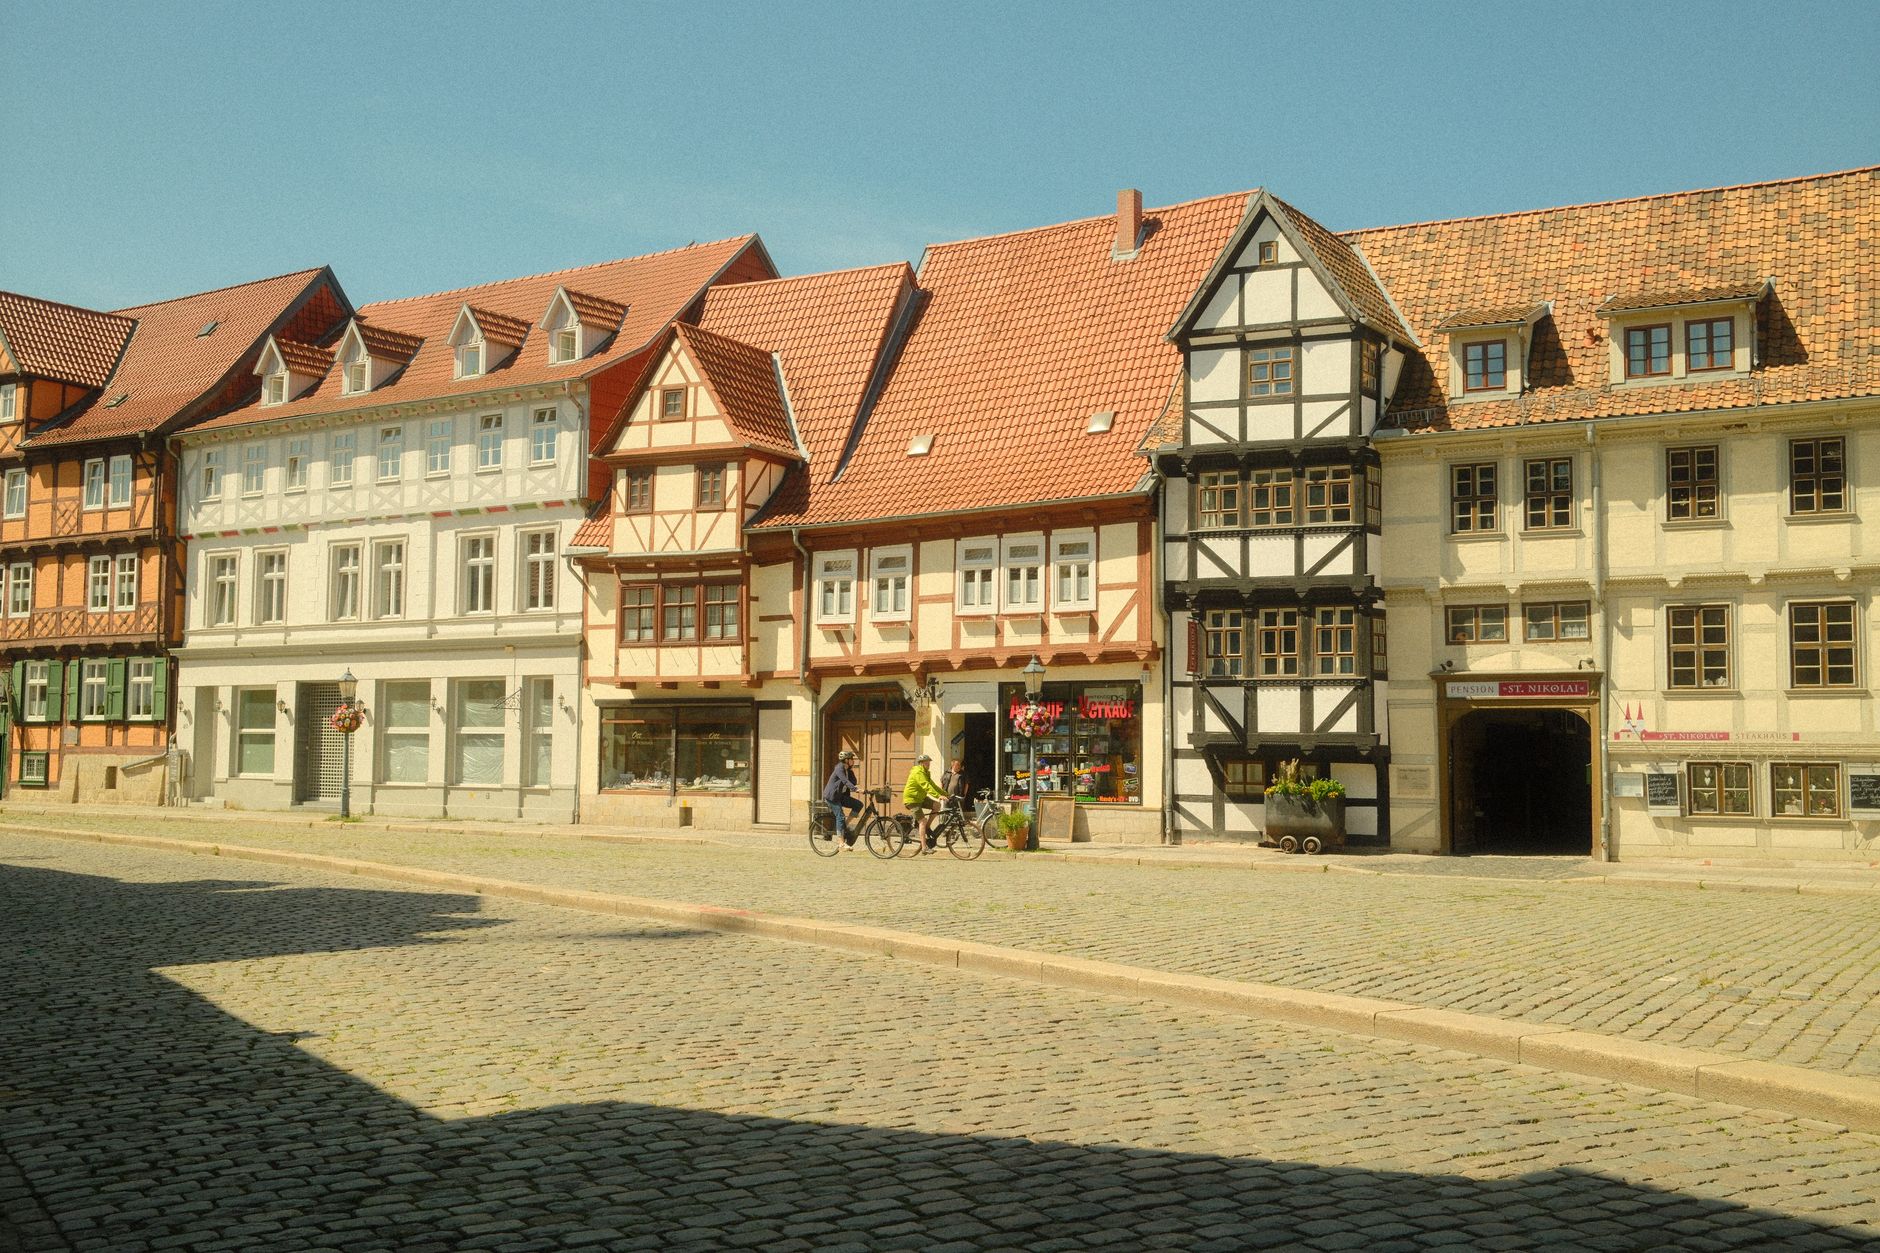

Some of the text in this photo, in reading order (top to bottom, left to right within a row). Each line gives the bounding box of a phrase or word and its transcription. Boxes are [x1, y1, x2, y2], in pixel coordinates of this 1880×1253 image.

[1450, 685, 1495, 694] PENSION
[1528, 684, 1579, 693] NIKOLAI
[1679, 732, 1719, 740] NIKOLAI
[1735, 732, 1788, 740] STEAKHAUS
